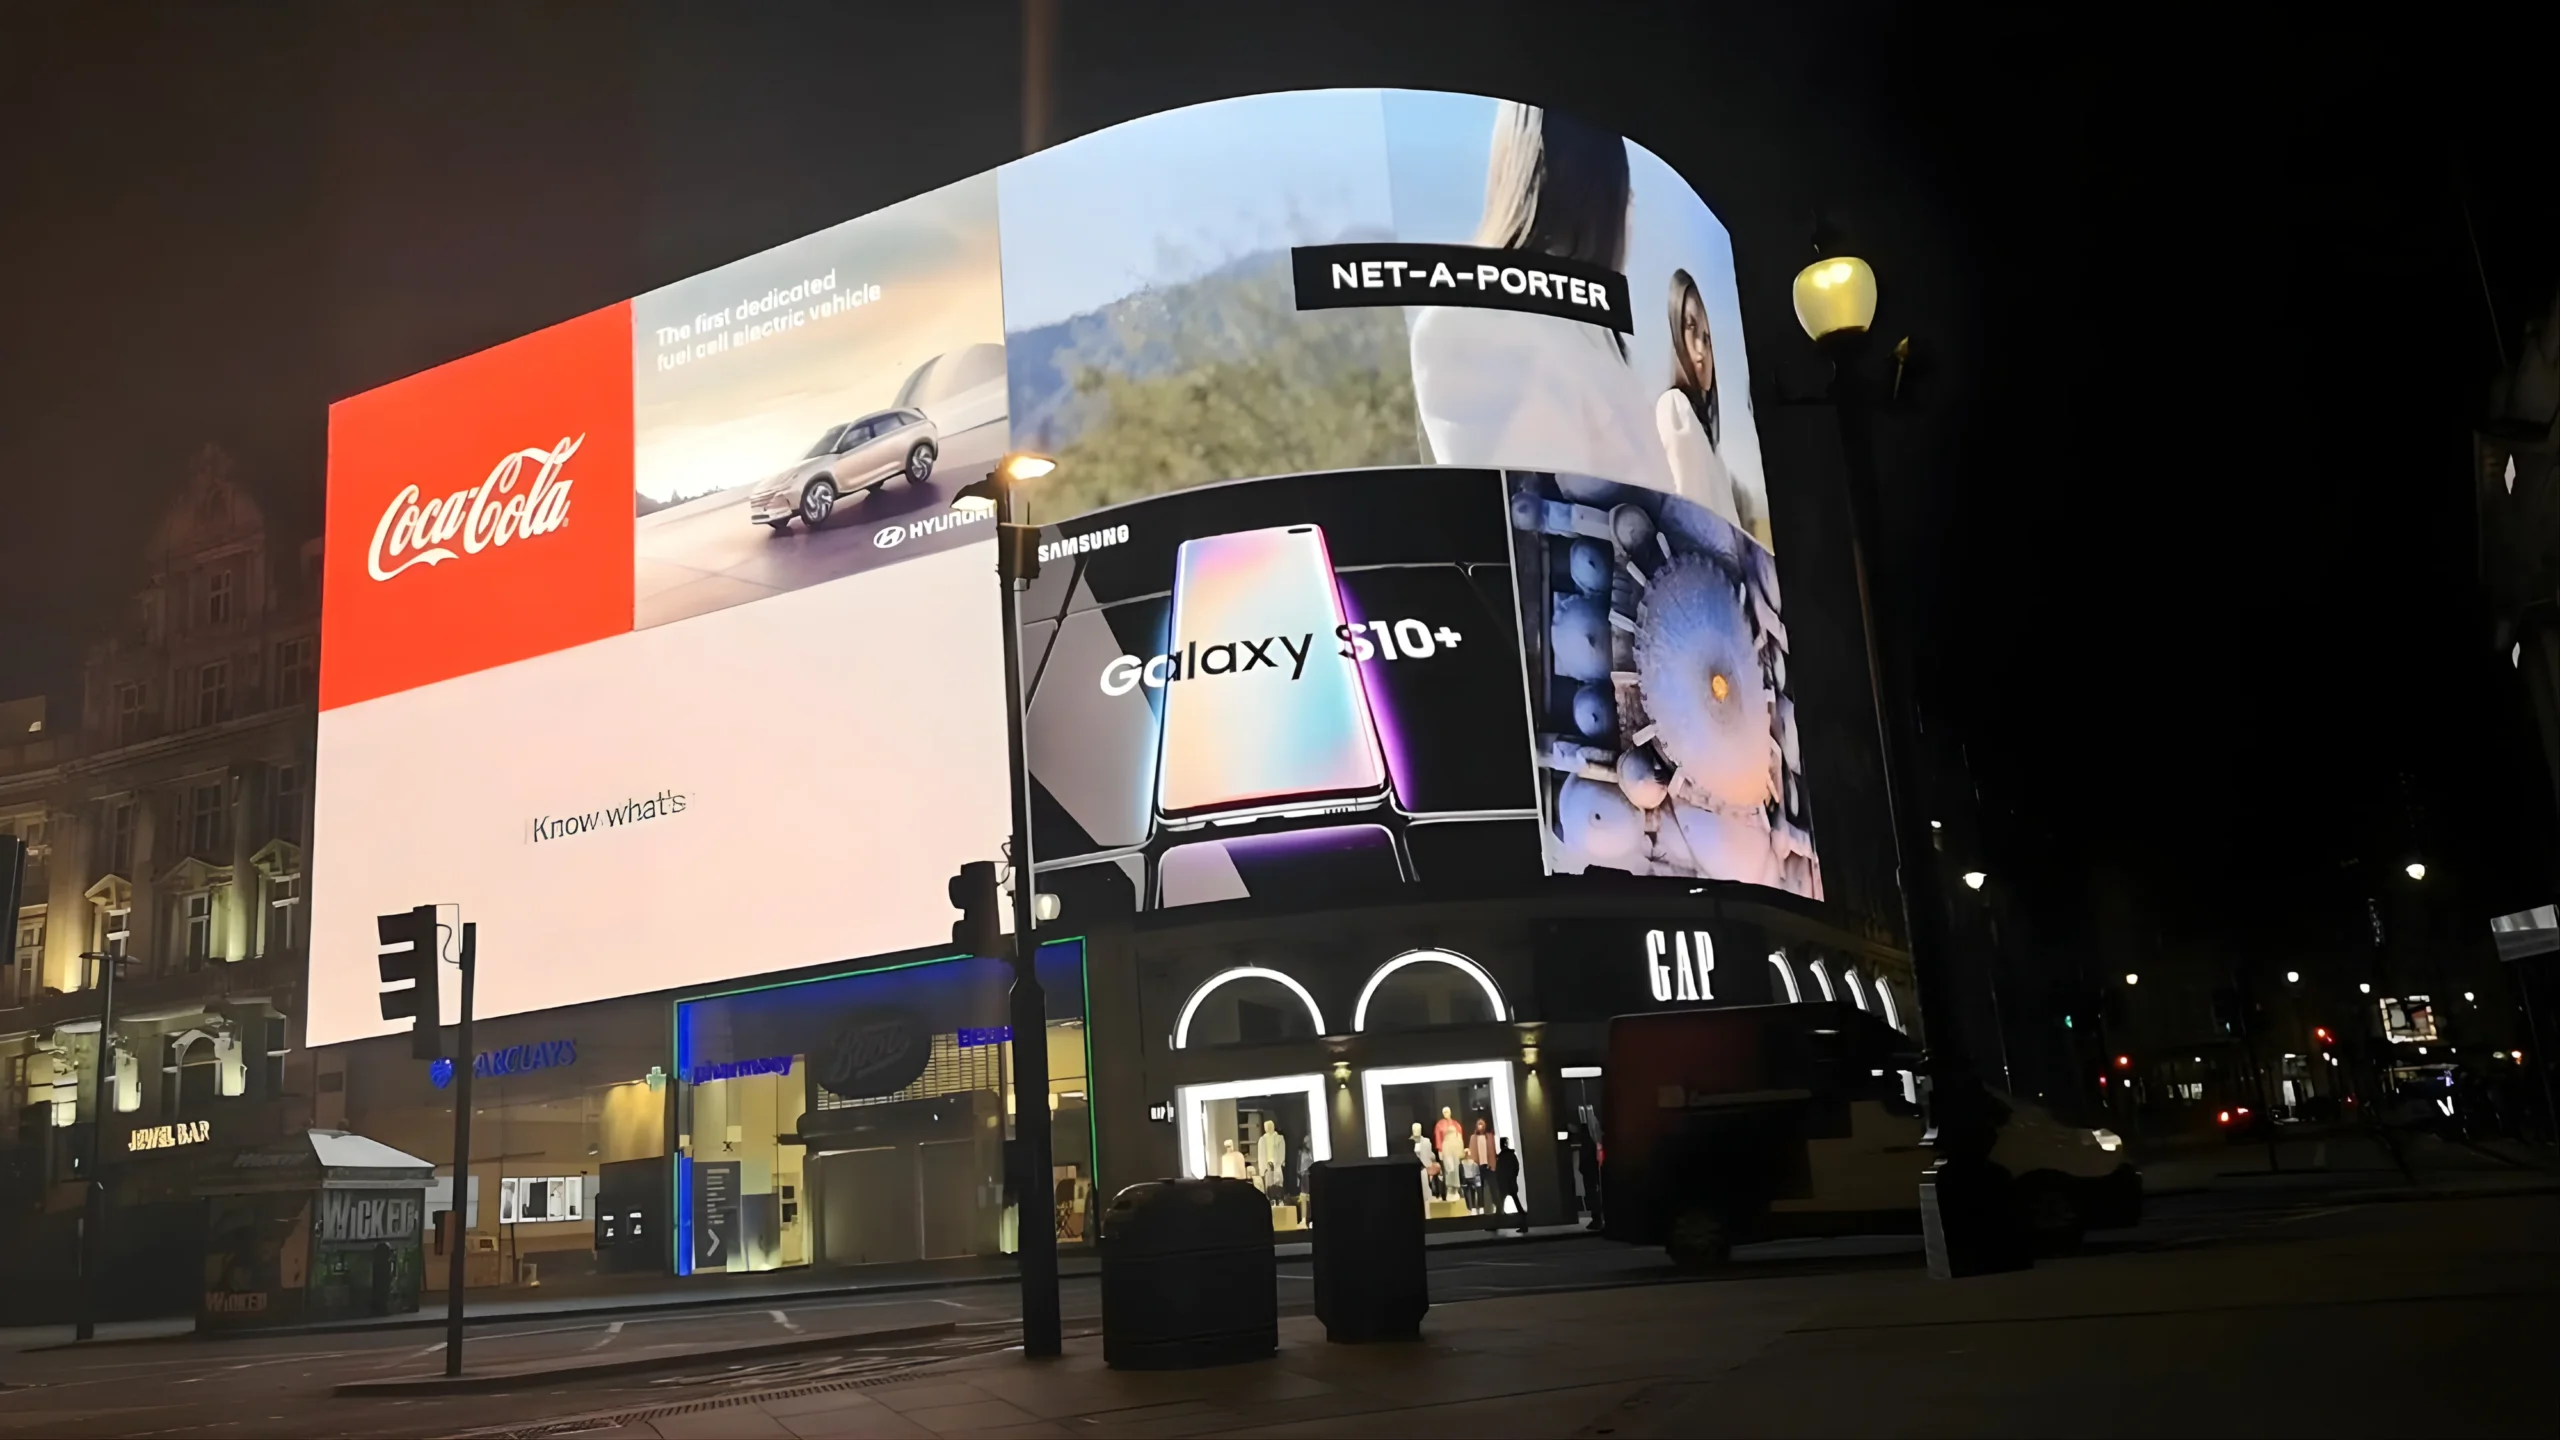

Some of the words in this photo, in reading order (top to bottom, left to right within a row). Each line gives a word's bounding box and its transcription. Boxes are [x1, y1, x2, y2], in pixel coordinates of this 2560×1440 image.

[656, 326, 690, 347] The
[695, 308, 730, 335] first
[736, 268, 836, 321] dedicated
[1331, 261, 1611, 311] NET-A-PORTER
[657, 344, 690, 372] fuel
[695, 331, 728, 358] cell
[733, 309, 804, 347] electric
[810, 283, 882, 321] vehicle
[368, 432, 586, 582] Coca-Cola
[909, 503, 994, 539] HYUNDAI
[1038, 524, 1130, 562] SAMSUNG
[1100, 632, 1313, 697] Galaxy
[1335, 618, 1462, 663] S10+
[533, 811, 600, 843] Know
[606, 789, 687, 827] what's
[1646, 929, 1715, 1001] GAP
[473, 1039, 577, 1080] ARCLAYS
[177, 1120, 210, 1145] BAR
